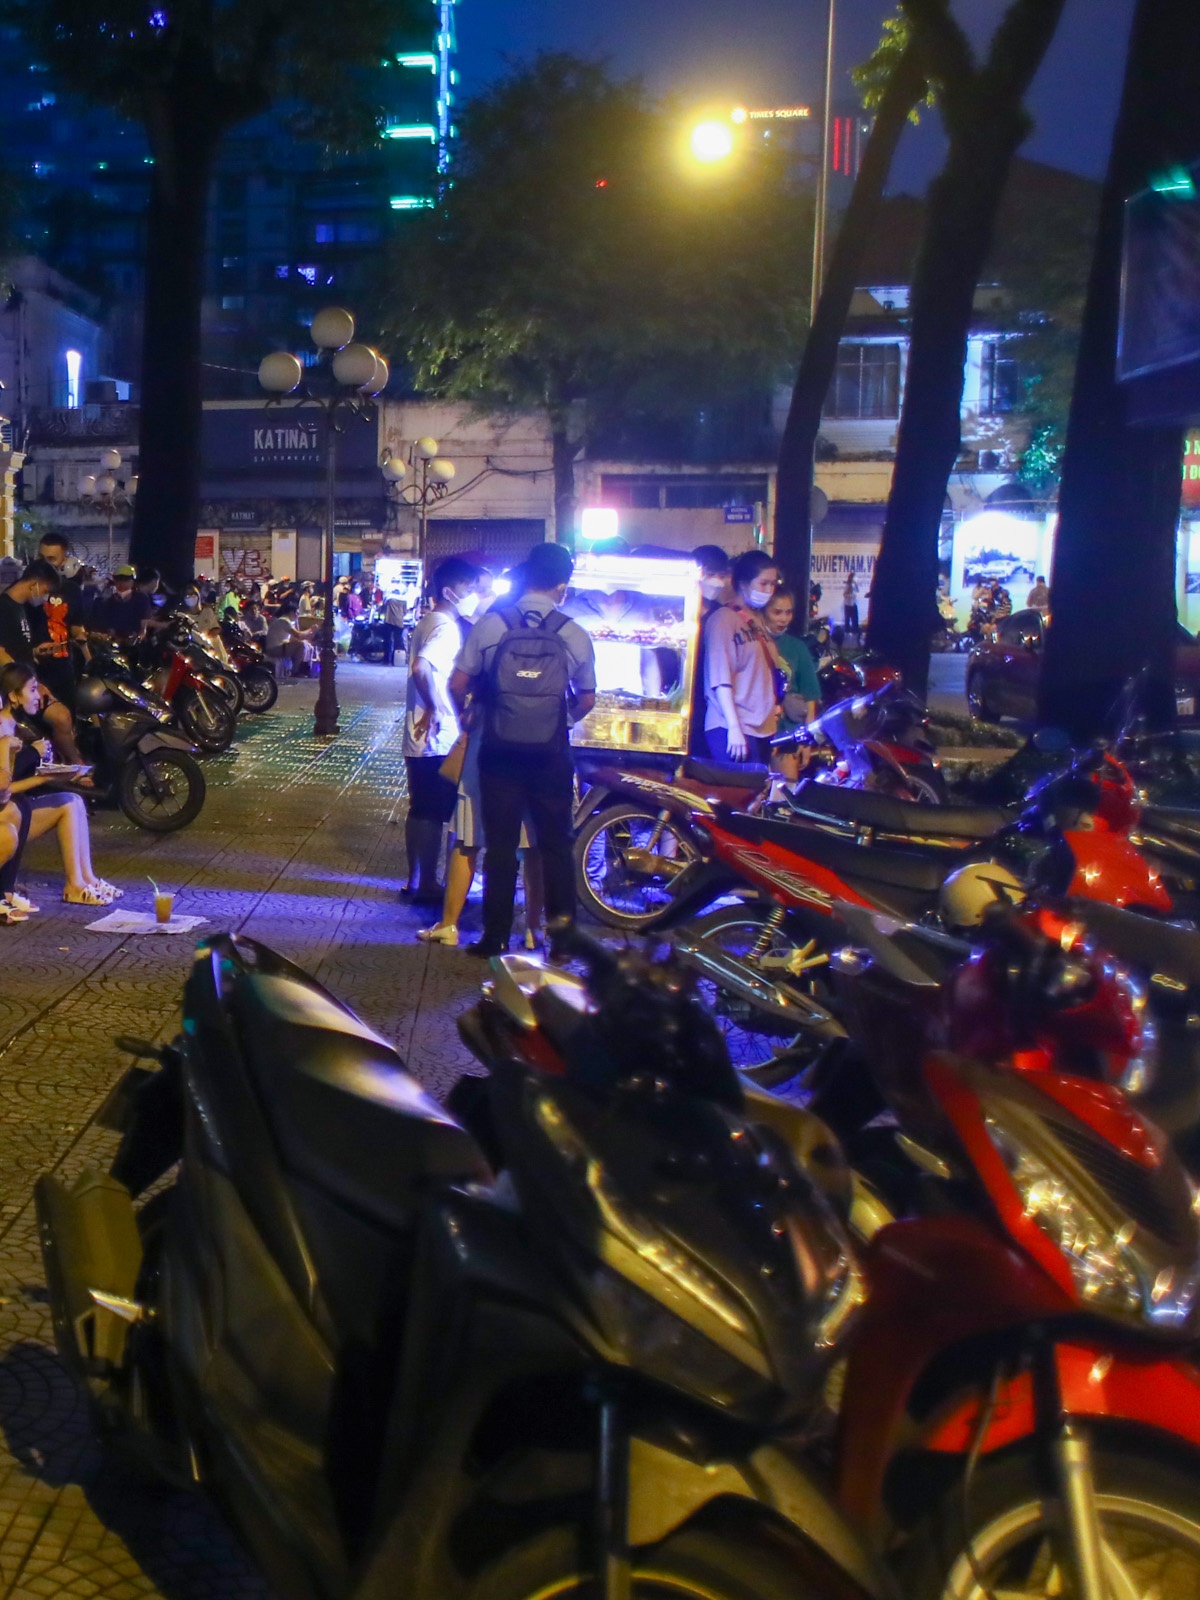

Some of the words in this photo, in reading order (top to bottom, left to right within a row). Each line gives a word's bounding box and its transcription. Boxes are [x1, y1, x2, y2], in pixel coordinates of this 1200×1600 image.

[749, 111, 774, 119] TIMES
[775, 108, 809, 118] SQUARE
[254, 429, 318, 449] KATINAT
[516, 670, 541, 678] acer
